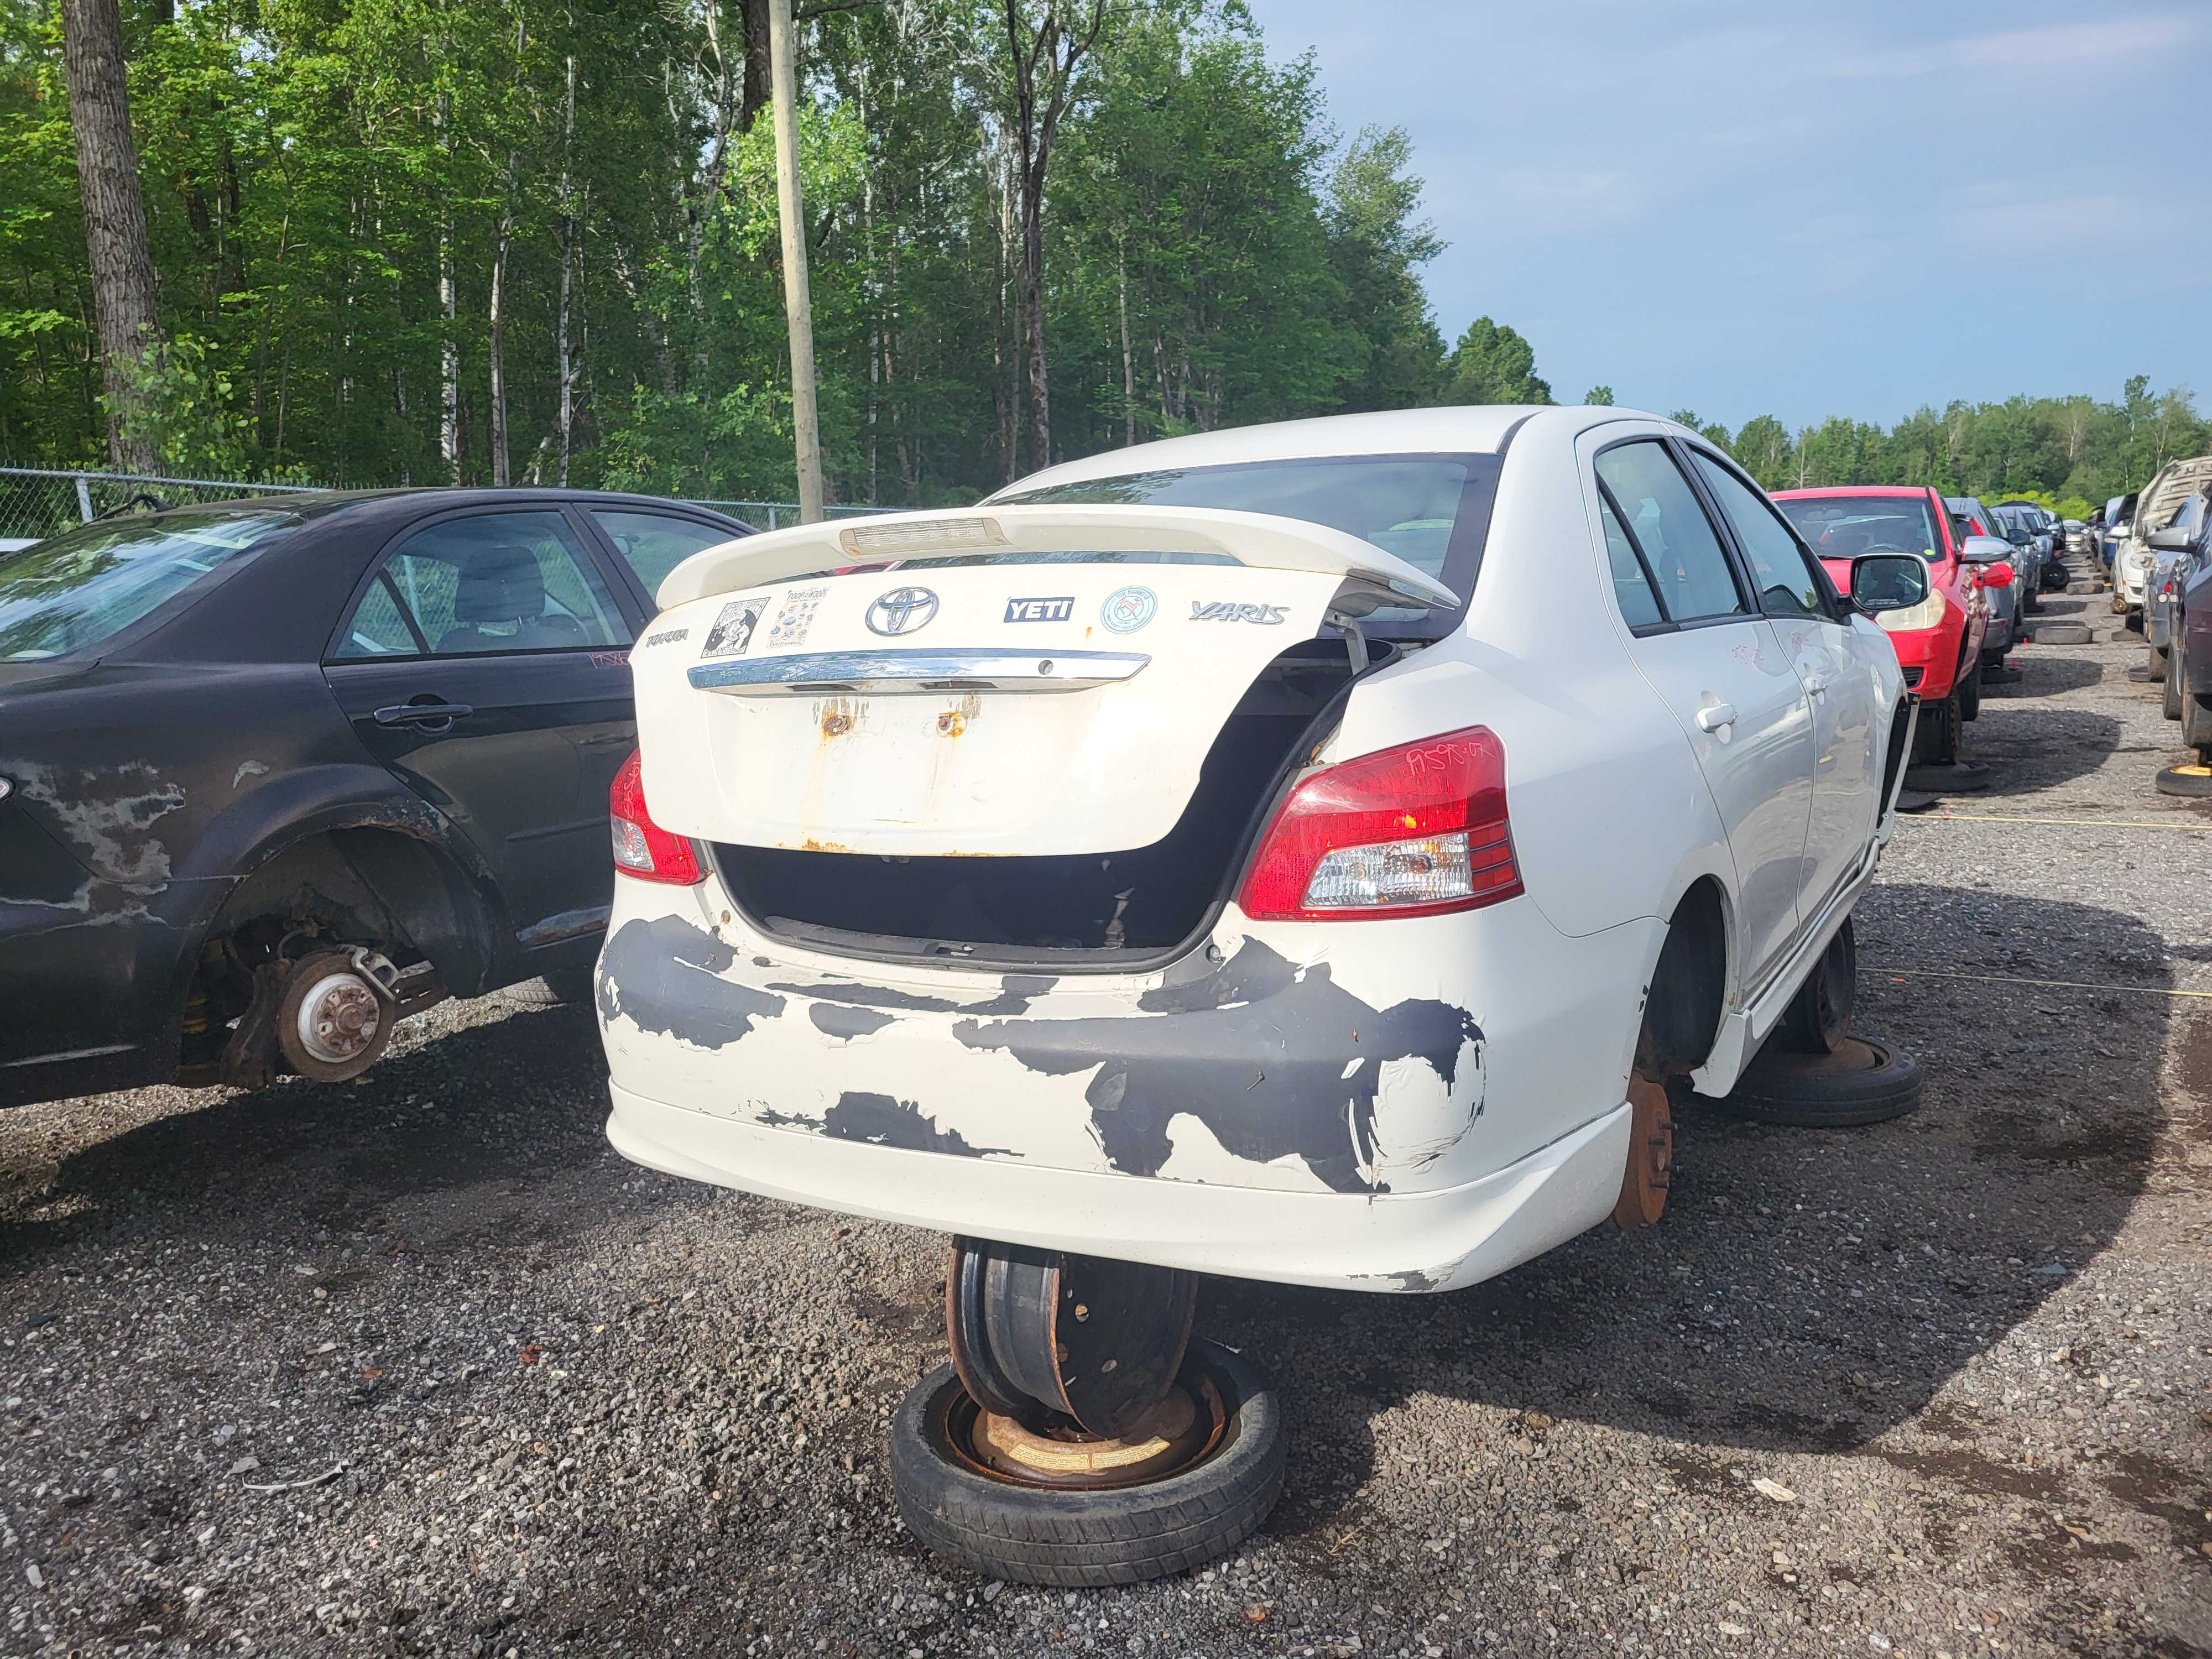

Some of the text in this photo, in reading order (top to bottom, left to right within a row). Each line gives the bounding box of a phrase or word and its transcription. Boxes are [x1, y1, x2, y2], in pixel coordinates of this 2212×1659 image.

[1010, 601, 1072, 619] YETI
[1188, 601, 1291, 625] YARIS
[646, 628, 689, 648] TOYOTA
